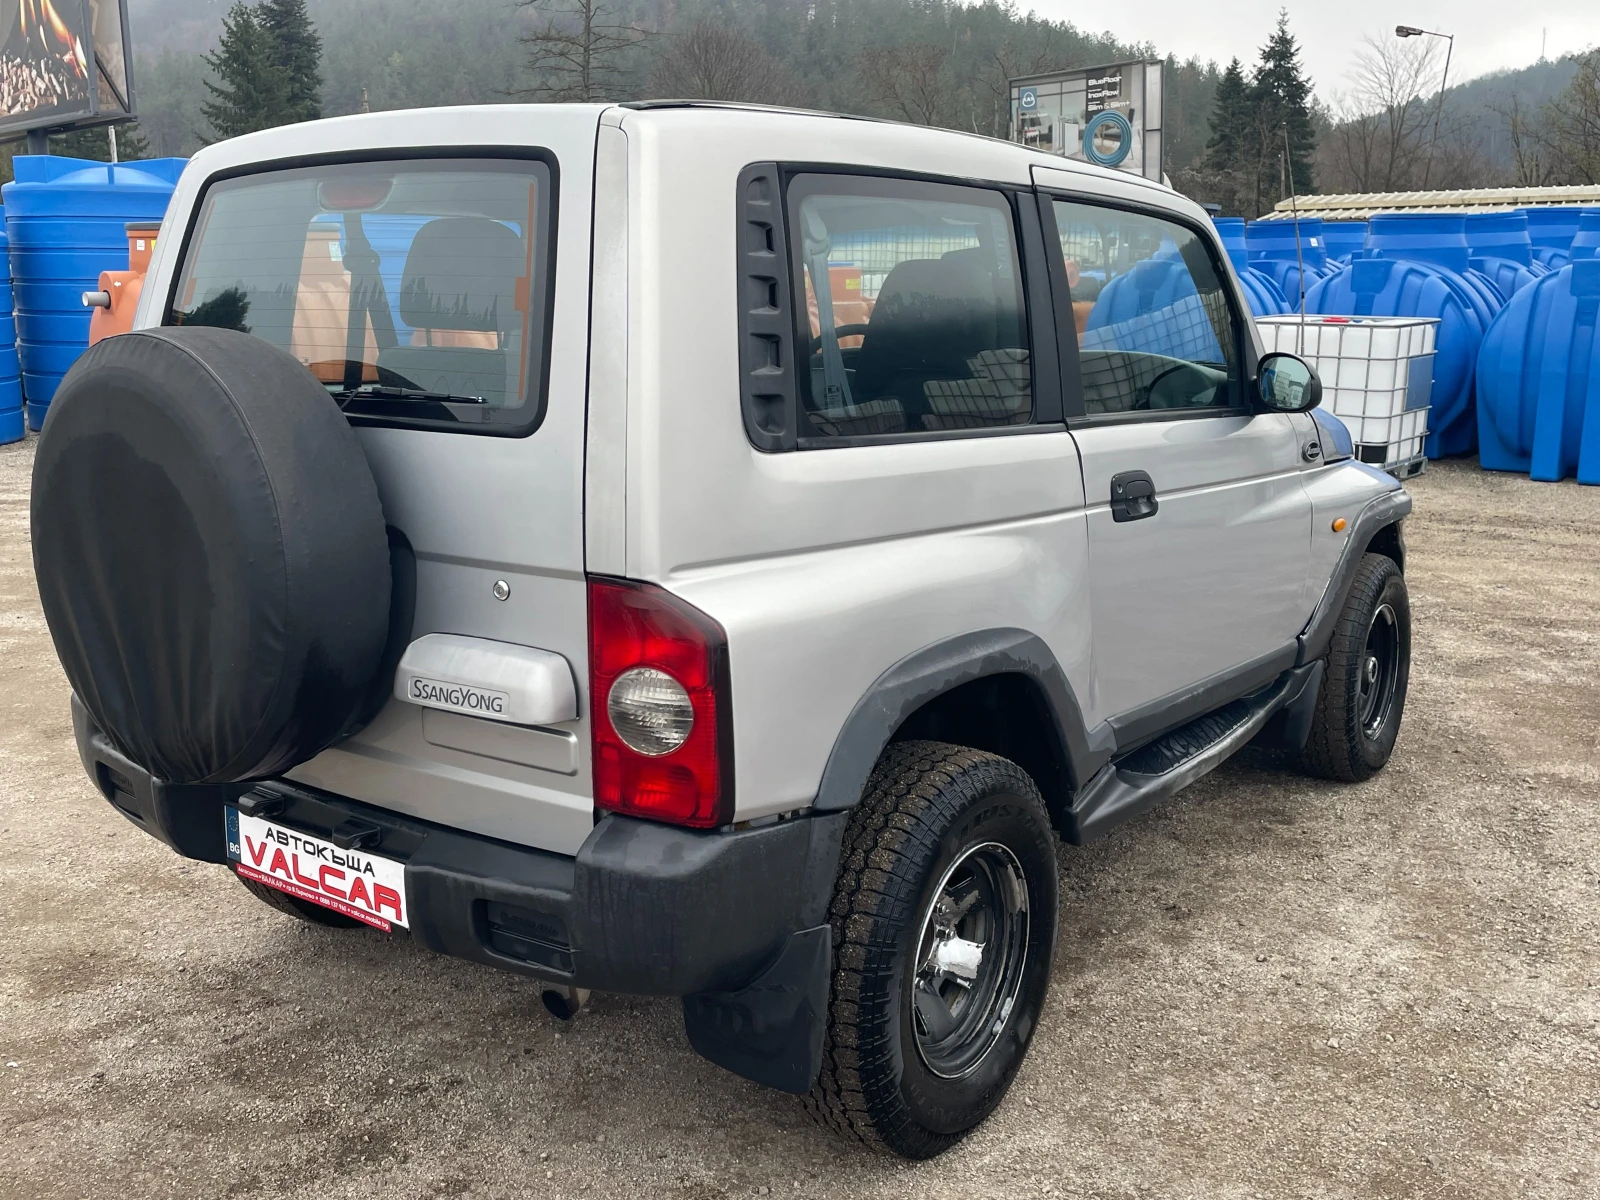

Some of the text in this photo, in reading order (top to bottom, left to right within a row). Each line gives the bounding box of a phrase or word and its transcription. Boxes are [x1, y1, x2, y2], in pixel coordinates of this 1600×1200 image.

[1088, 76, 1122, 86] BlueFloor
[1088, 104, 1103, 112] Slim
[229, 842, 240, 855] BG
[265, 826, 376, 878] АВТОКЪЩА
[244, 834, 403, 921] VALCAR
